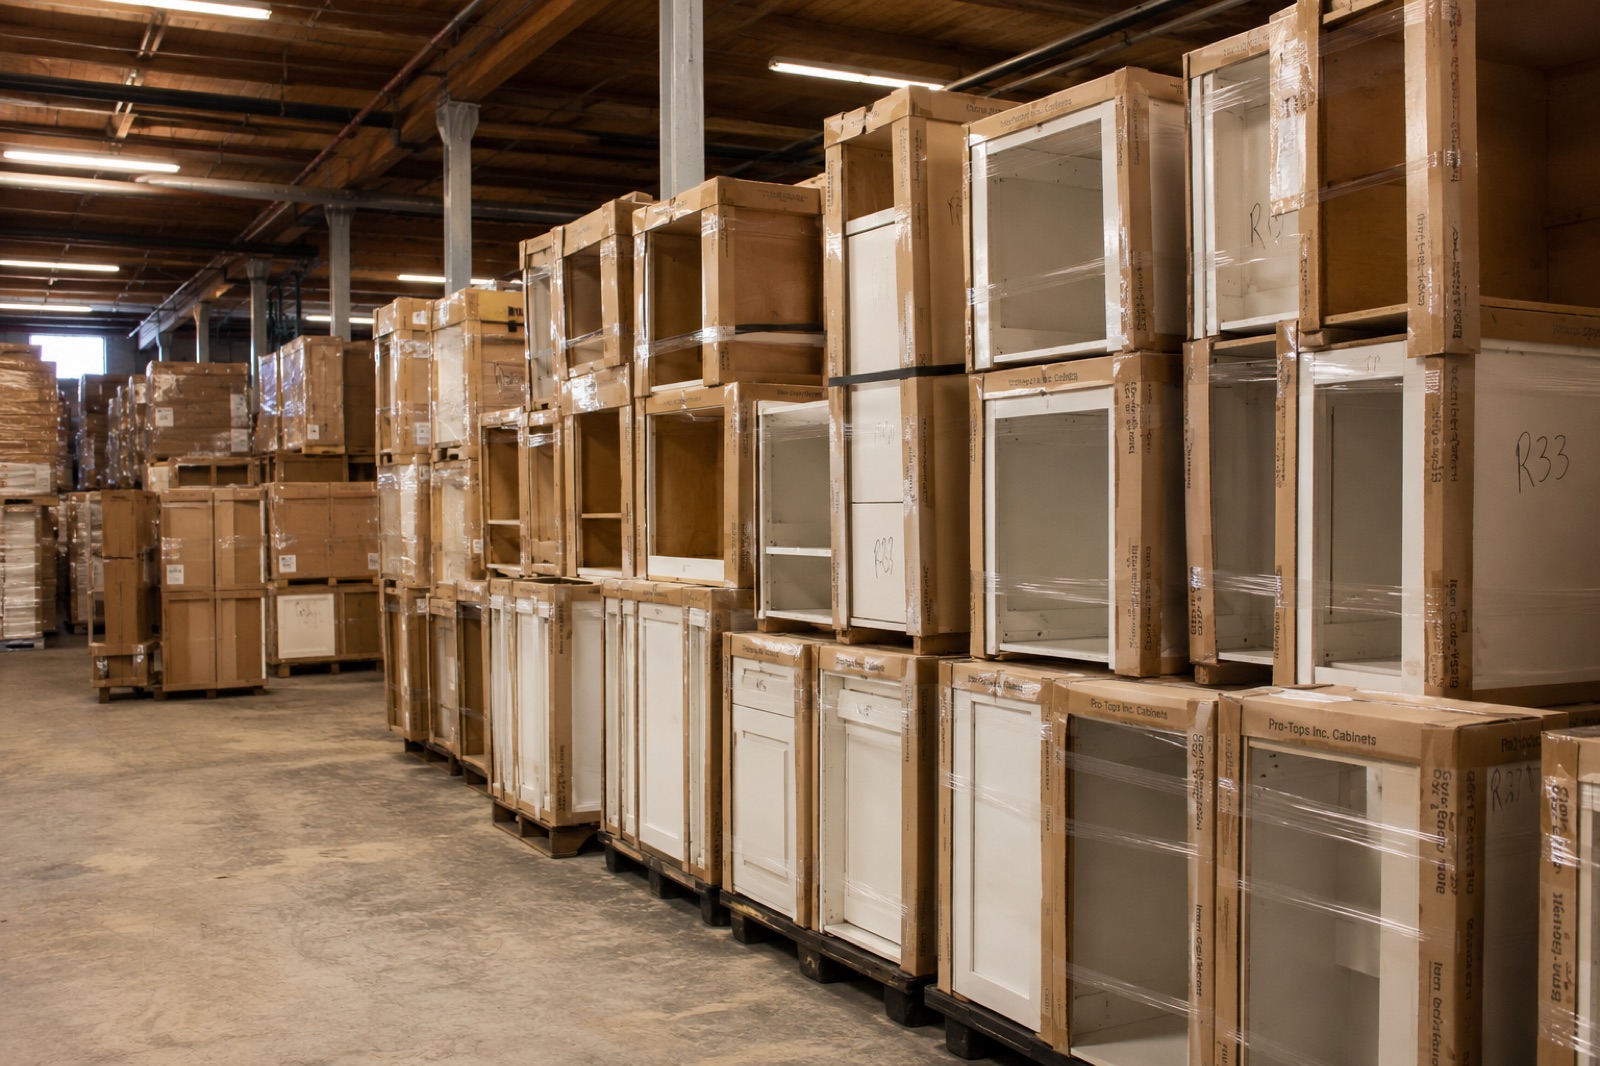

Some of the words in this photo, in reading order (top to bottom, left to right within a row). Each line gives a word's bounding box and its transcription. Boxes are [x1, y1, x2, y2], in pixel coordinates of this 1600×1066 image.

[1515, 431, 1570, 493] R33
[1136, 706, 1168, 720] Cabinets
[1268, 718, 1310, 737] Pro-Tops
[1312, 726, 1330, 739] Inc.
[1332, 729, 1377, 746] Cabinets
